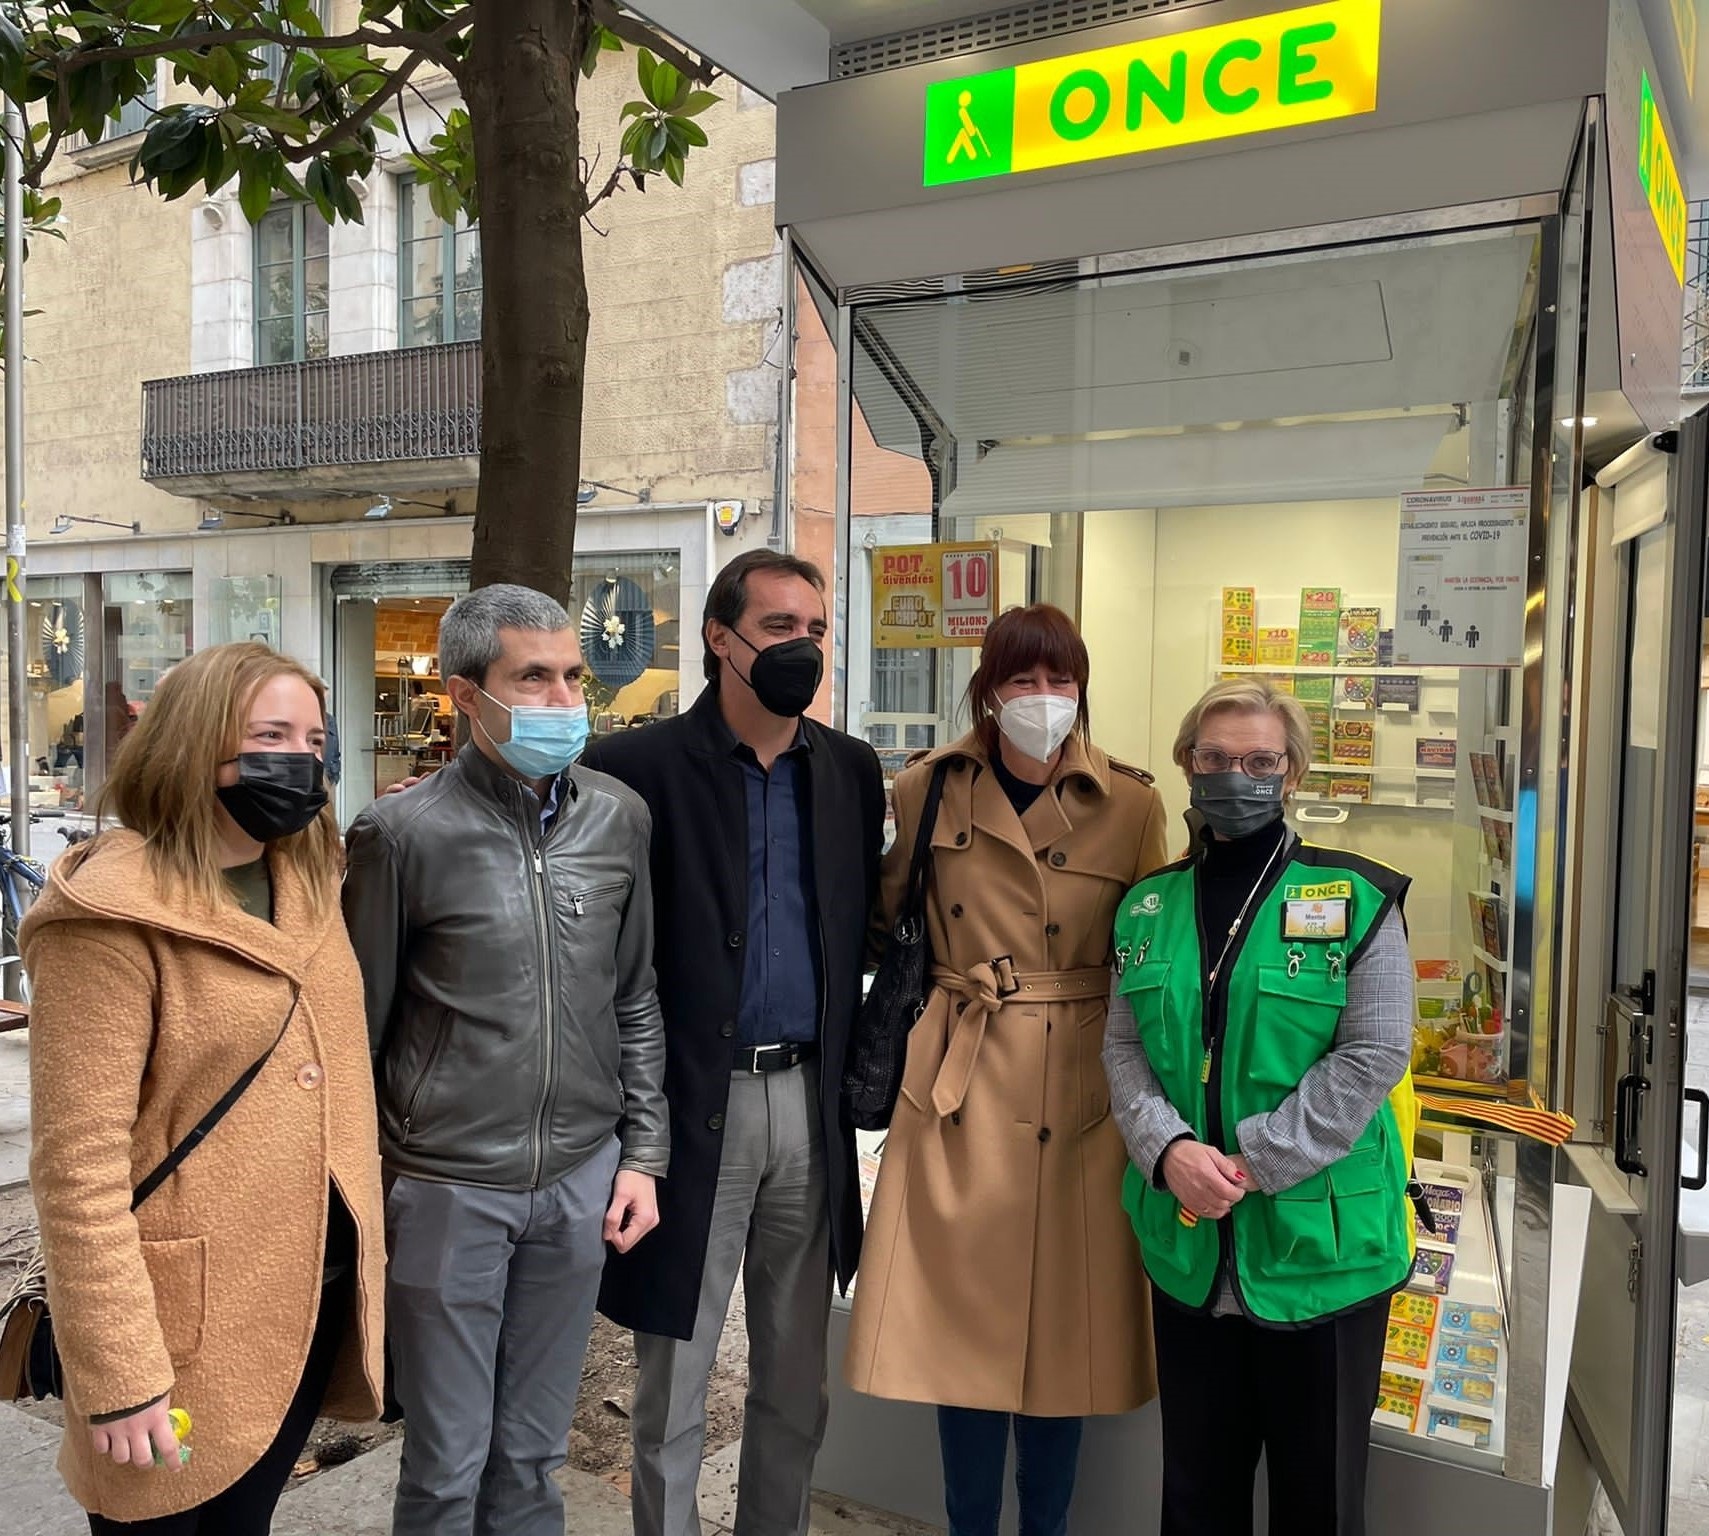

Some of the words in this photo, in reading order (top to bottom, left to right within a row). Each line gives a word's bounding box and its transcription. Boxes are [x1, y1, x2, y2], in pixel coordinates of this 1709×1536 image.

[1049, 21, 1337, 142] ONCE
[1656, 142, 1683, 268] ONCE
[1406, 496, 1452, 504] CORONAVIRUS
[1469, 530, 1500, 541] COVID-19
[883, 555, 923, 574] POT
[883, 574, 934, 585] divendres
[947, 556, 986, 600] 10
[891, 595, 924, 611] EURO
[1305, 591, 1335, 602] x20
[881, 610, 936, 628] JACKPOT
[947, 615, 988, 626] MILIONS
[1267, 629, 1289, 638] x10
[1305, 883, 1347, 898] ONCE
